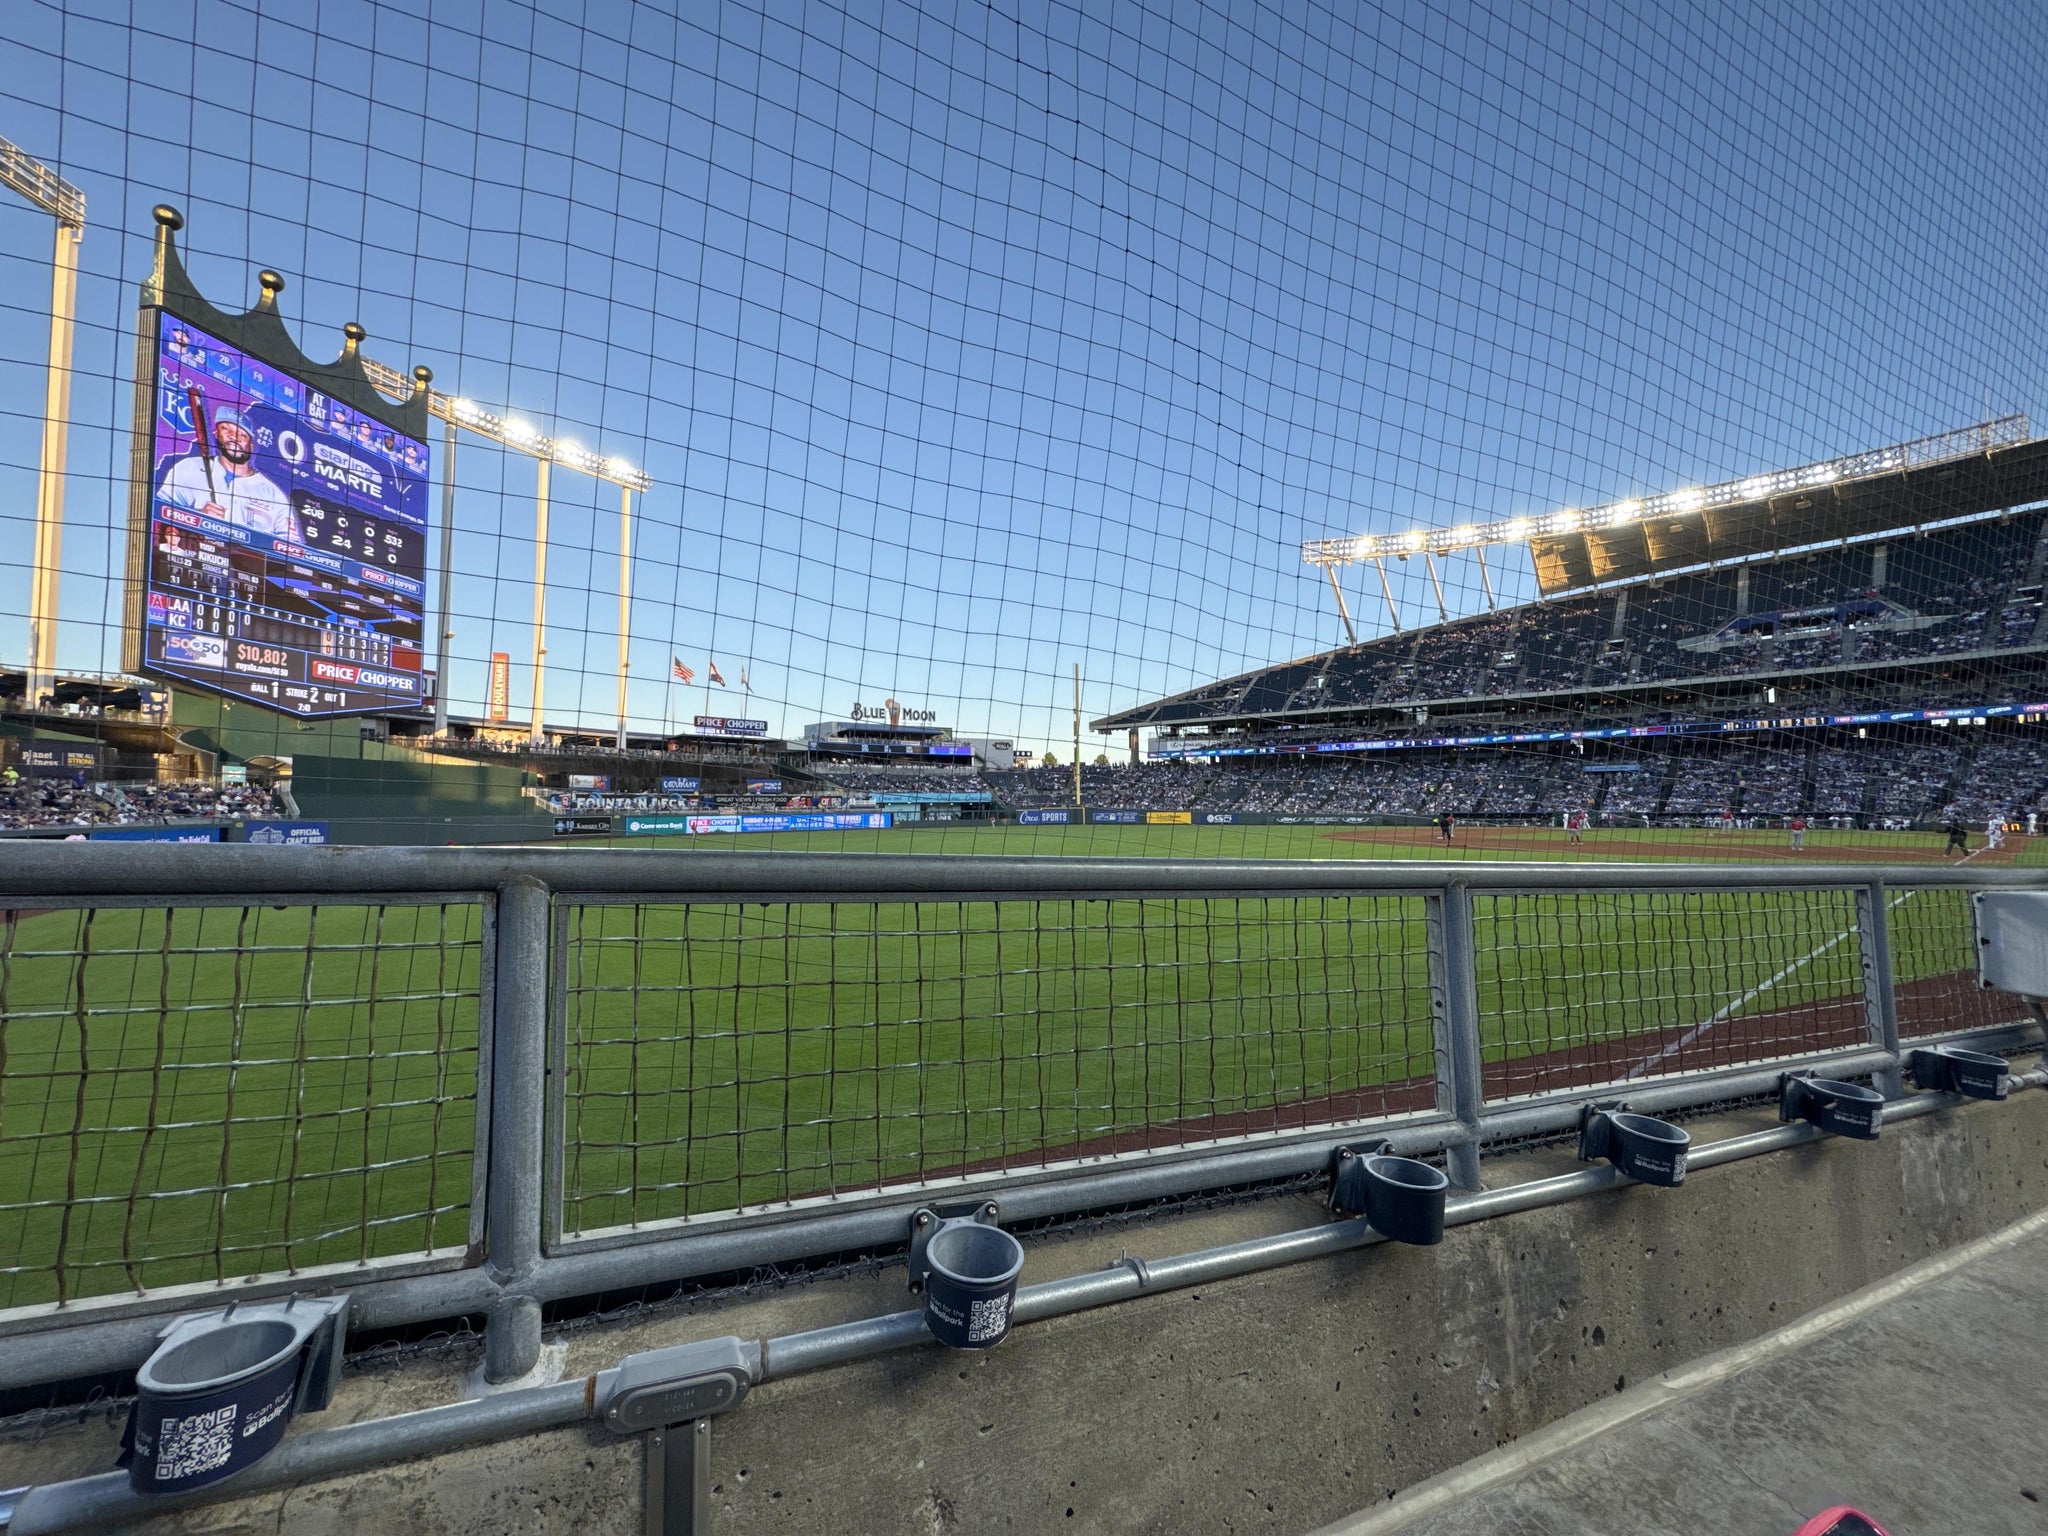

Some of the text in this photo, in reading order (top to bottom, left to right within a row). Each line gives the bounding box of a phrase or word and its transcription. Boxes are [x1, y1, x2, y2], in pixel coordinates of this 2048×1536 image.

[220, 355, 230, 366] 2B
[313, 393, 325, 408] AT
[309, 403, 327, 423] BAT
[315, 460, 383, 499] MARTE
[166, 509, 247, 540] PRICE CHOPPER
[306, 526, 318, 538] 5
[364, 527, 375, 537] 0
[331, 535, 352, 549] 24
[198, 551, 230, 567] KIKUCHI
[363, 546, 375, 557] 2
[387, 554, 397, 564] 0
[365, 570, 385, 582] PRICE
[387, 577, 417, 592] CHOPPER
[168, 599, 190, 613] LAA
[197, 604, 204, 616] 0
[213, 607, 220, 619] 0
[228, 611, 235, 622] 0
[244, 614, 251, 625] 0
[349, 637, 355, 647] 0
[168, 612, 187, 628] KC
[196, 619, 204, 630] 0
[212, 622, 219, 633] 0
[228, 625, 235, 636] 0
[349, 649, 355, 659] 0
[170, 636, 221, 654] 50 50
[237, 643, 288, 666] $10,802
[317, 663, 414, 691] PRICE CHOPPER
[250, 682, 269, 694] BALL
[271, 681, 279, 699] 1
[285, 687, 309, 699] STRIKE
[309, 687, 319, 704] 2
[339, 692, 346, 707] 1
[851, 702, 936, 722] BLUE MOON
[697, 717, 766, 730] PRICE CHOPPER
[67, 757, 95, 765] STRONG
[1041, 812, 1068, 822] SPORTS
[286, 836, 308, 844] CRAFT
[290, 828, 321, 837] OFFICIAL
[934, 1306, 964, 1328] Ballpark
[942, 1304, 952, 1314] for
[953, 1309, 965, 1318] the
[245, 1392, 287, 1424] Scan for
